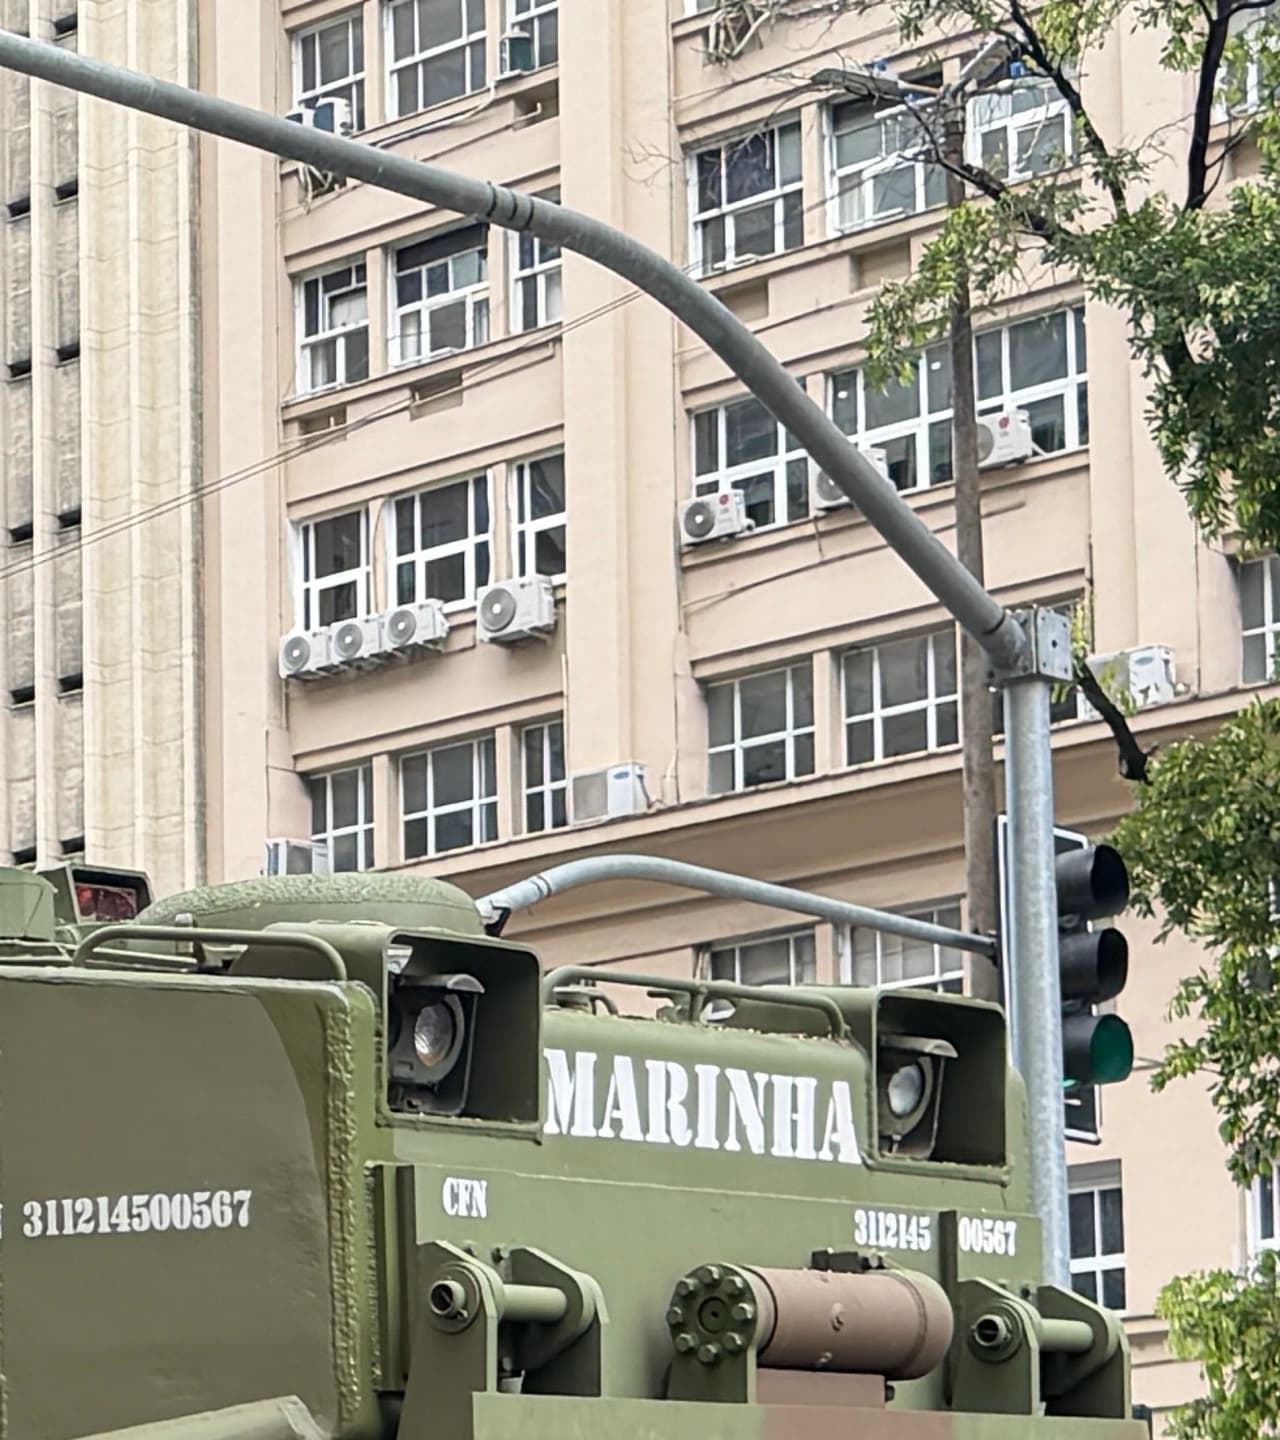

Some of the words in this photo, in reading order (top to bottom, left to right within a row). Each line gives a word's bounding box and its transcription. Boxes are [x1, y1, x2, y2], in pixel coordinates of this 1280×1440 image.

[543, 1048, 862, 1165] MARINHA
[23, 1190, 252, 1237] 311214500567
[442, 1177, 488, 1218] CFN
